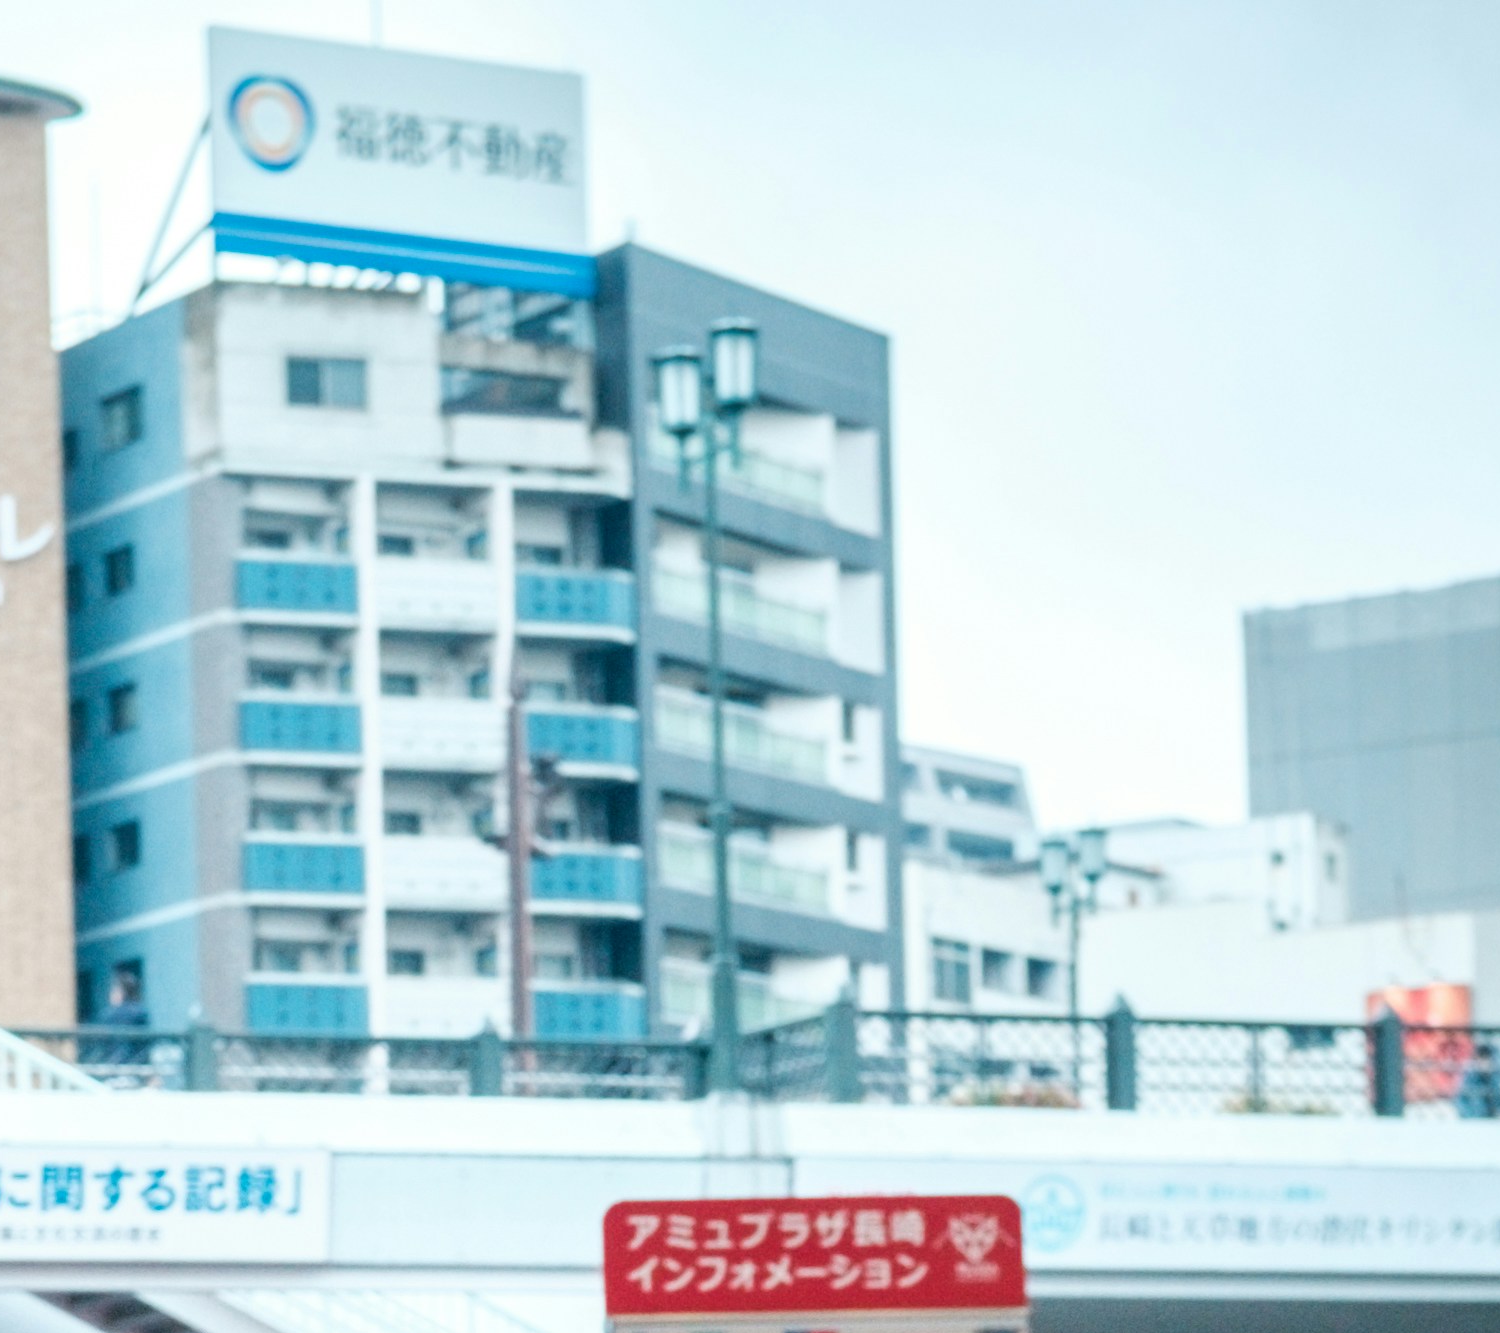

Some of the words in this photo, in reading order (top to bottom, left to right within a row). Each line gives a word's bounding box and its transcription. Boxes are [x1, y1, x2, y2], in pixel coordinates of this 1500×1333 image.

[625, 1208, 926, 1251] アミュプラザ長崎
[627, 1253, 930, 1293] インフォメーション
